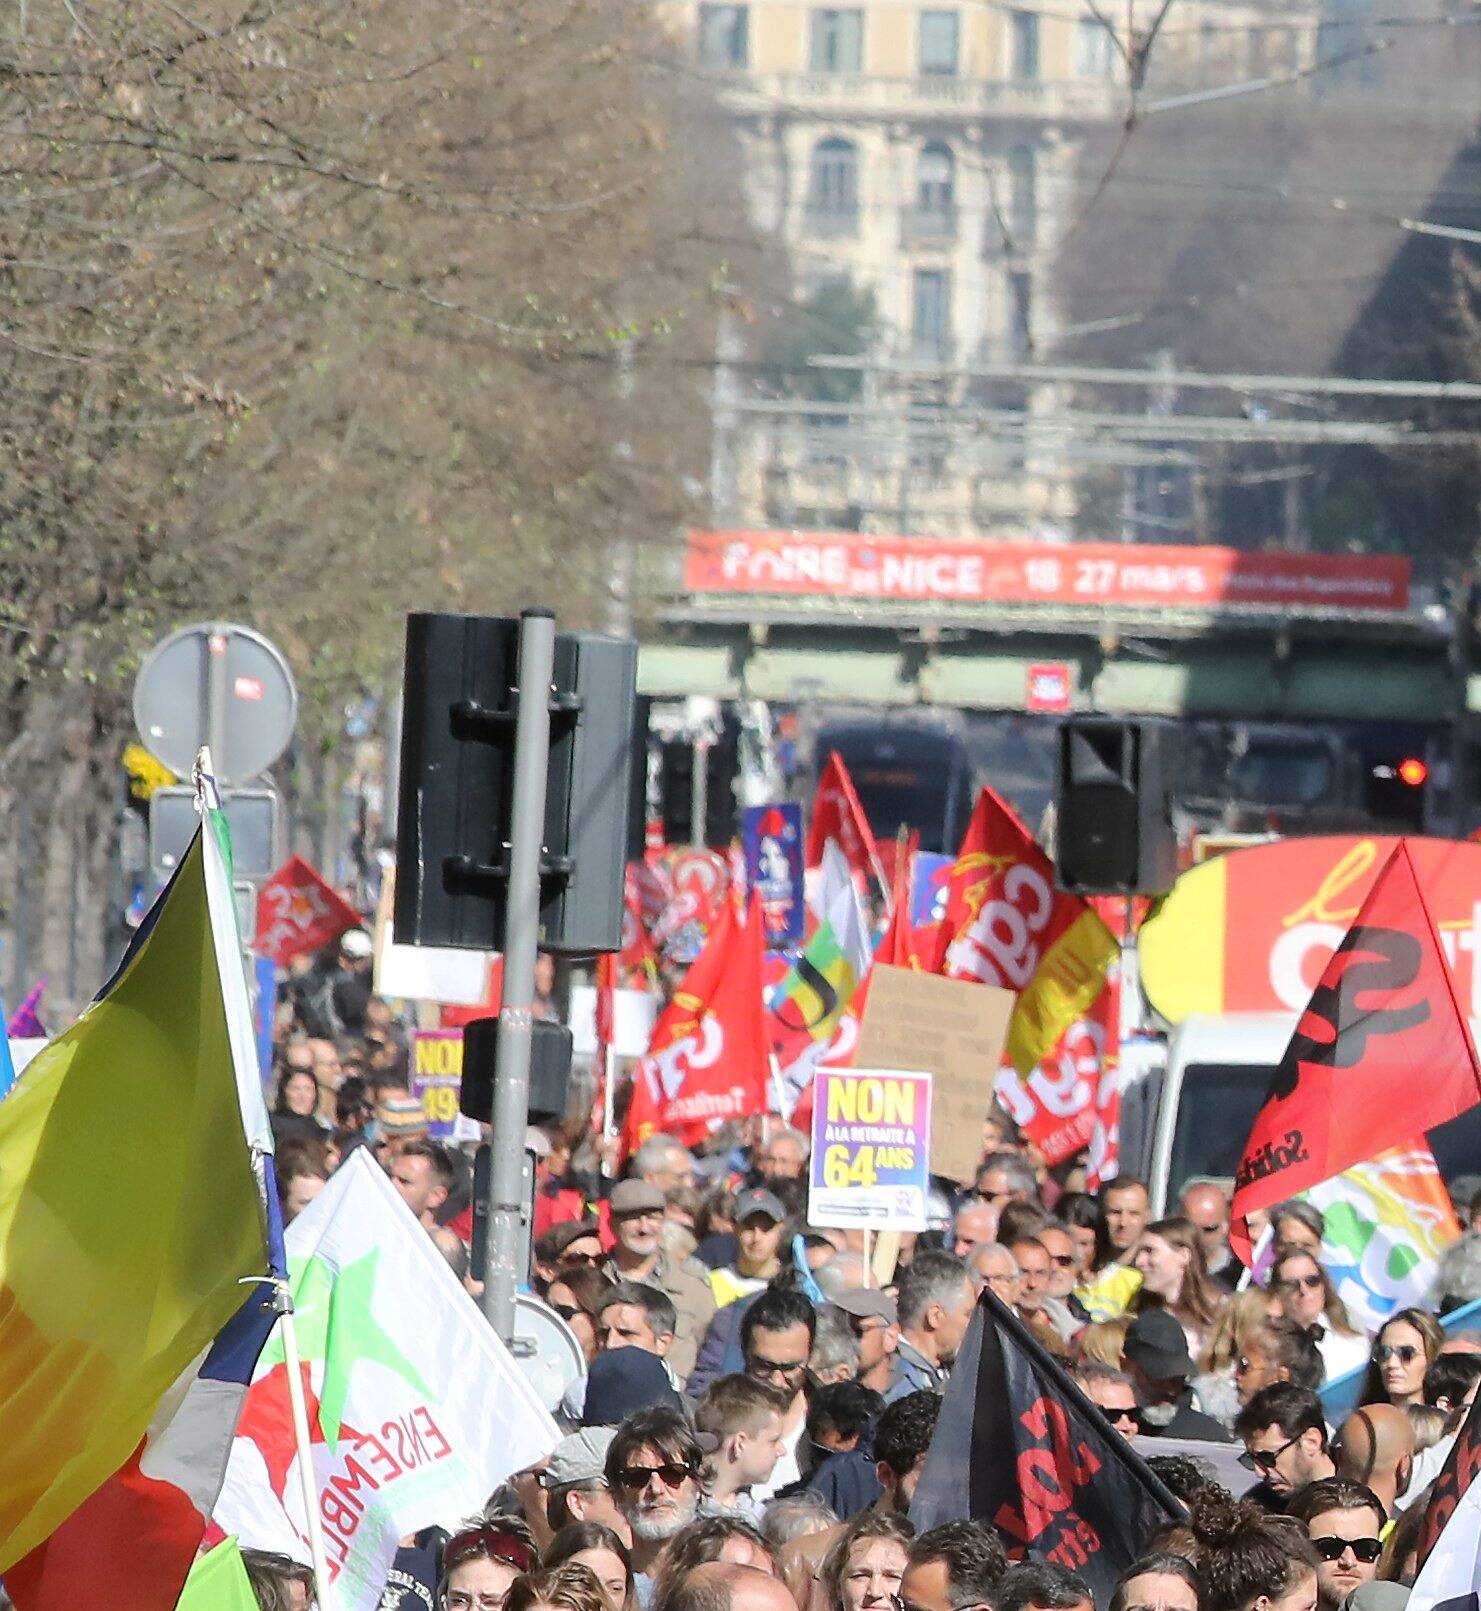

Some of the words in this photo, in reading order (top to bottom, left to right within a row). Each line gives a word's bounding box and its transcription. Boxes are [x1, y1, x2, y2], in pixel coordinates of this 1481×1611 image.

[883, 554, 984, 593] NICE
[1074, 560, 1117, 593] 27
[415, 1039, 464, 1077] NO
[827, 1077, 915, 1125] NON
[823, 1144, 877, 1189] 64
[876, 1146, 915, 1170] ANS
